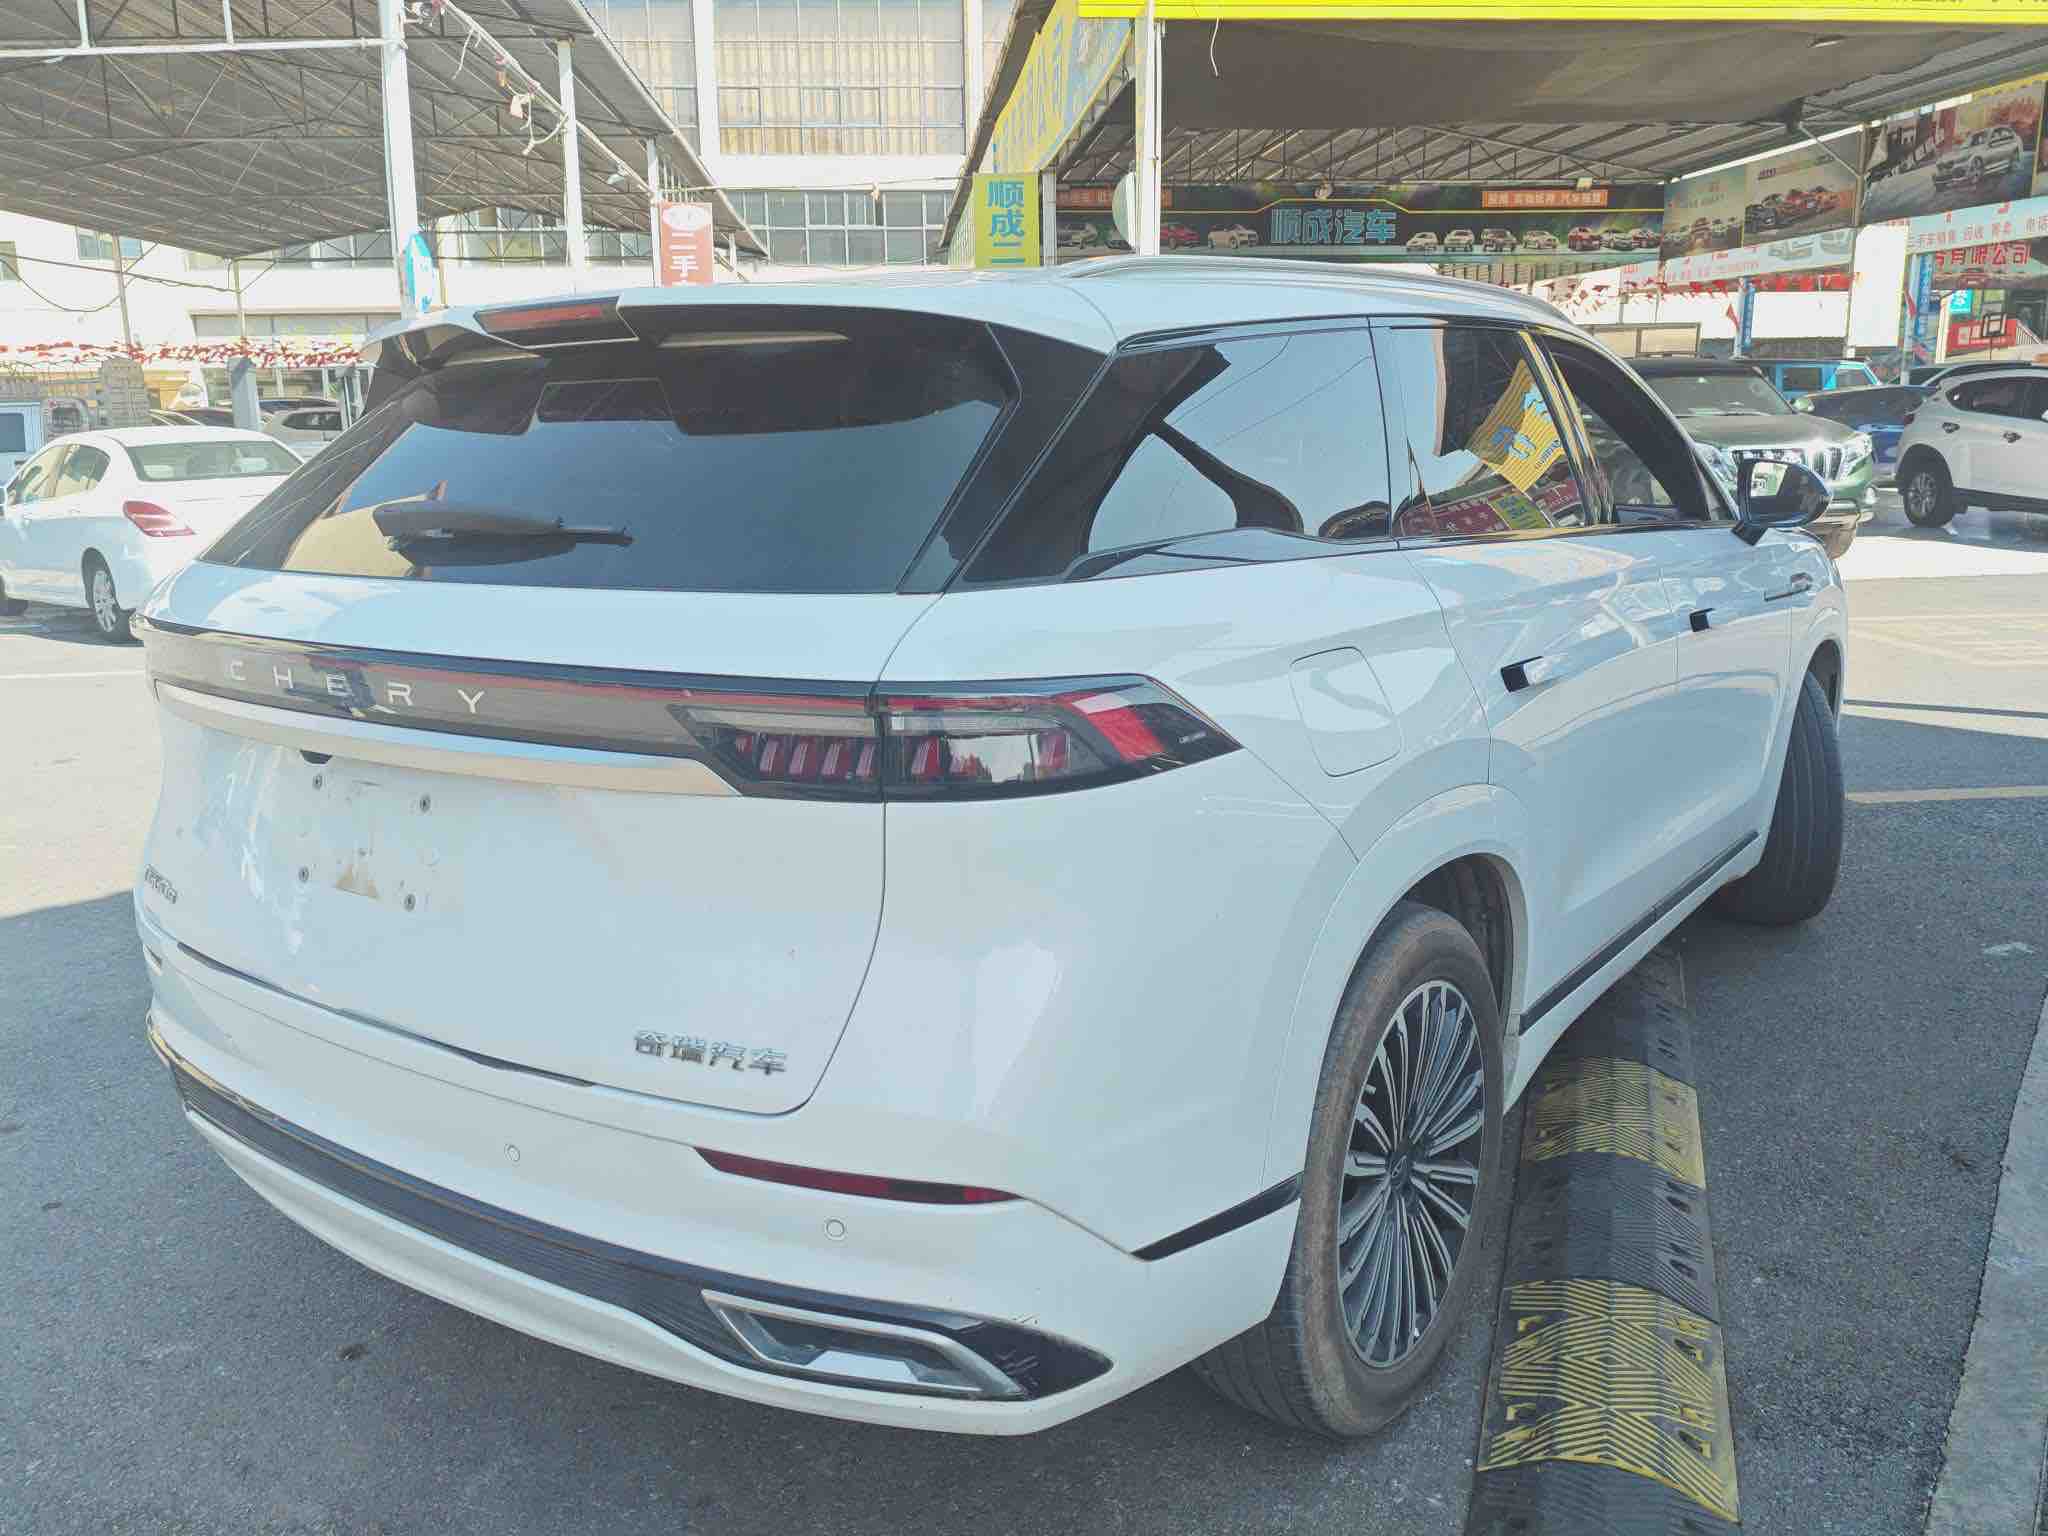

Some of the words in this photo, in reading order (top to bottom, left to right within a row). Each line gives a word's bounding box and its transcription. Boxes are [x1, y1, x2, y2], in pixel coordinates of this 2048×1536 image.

[1271, 208, 1398, 244] 顺成汽车
[228, 659, 486, 714] CHERY
[634, 1030, 787, 1076] 奇瑞汽车
